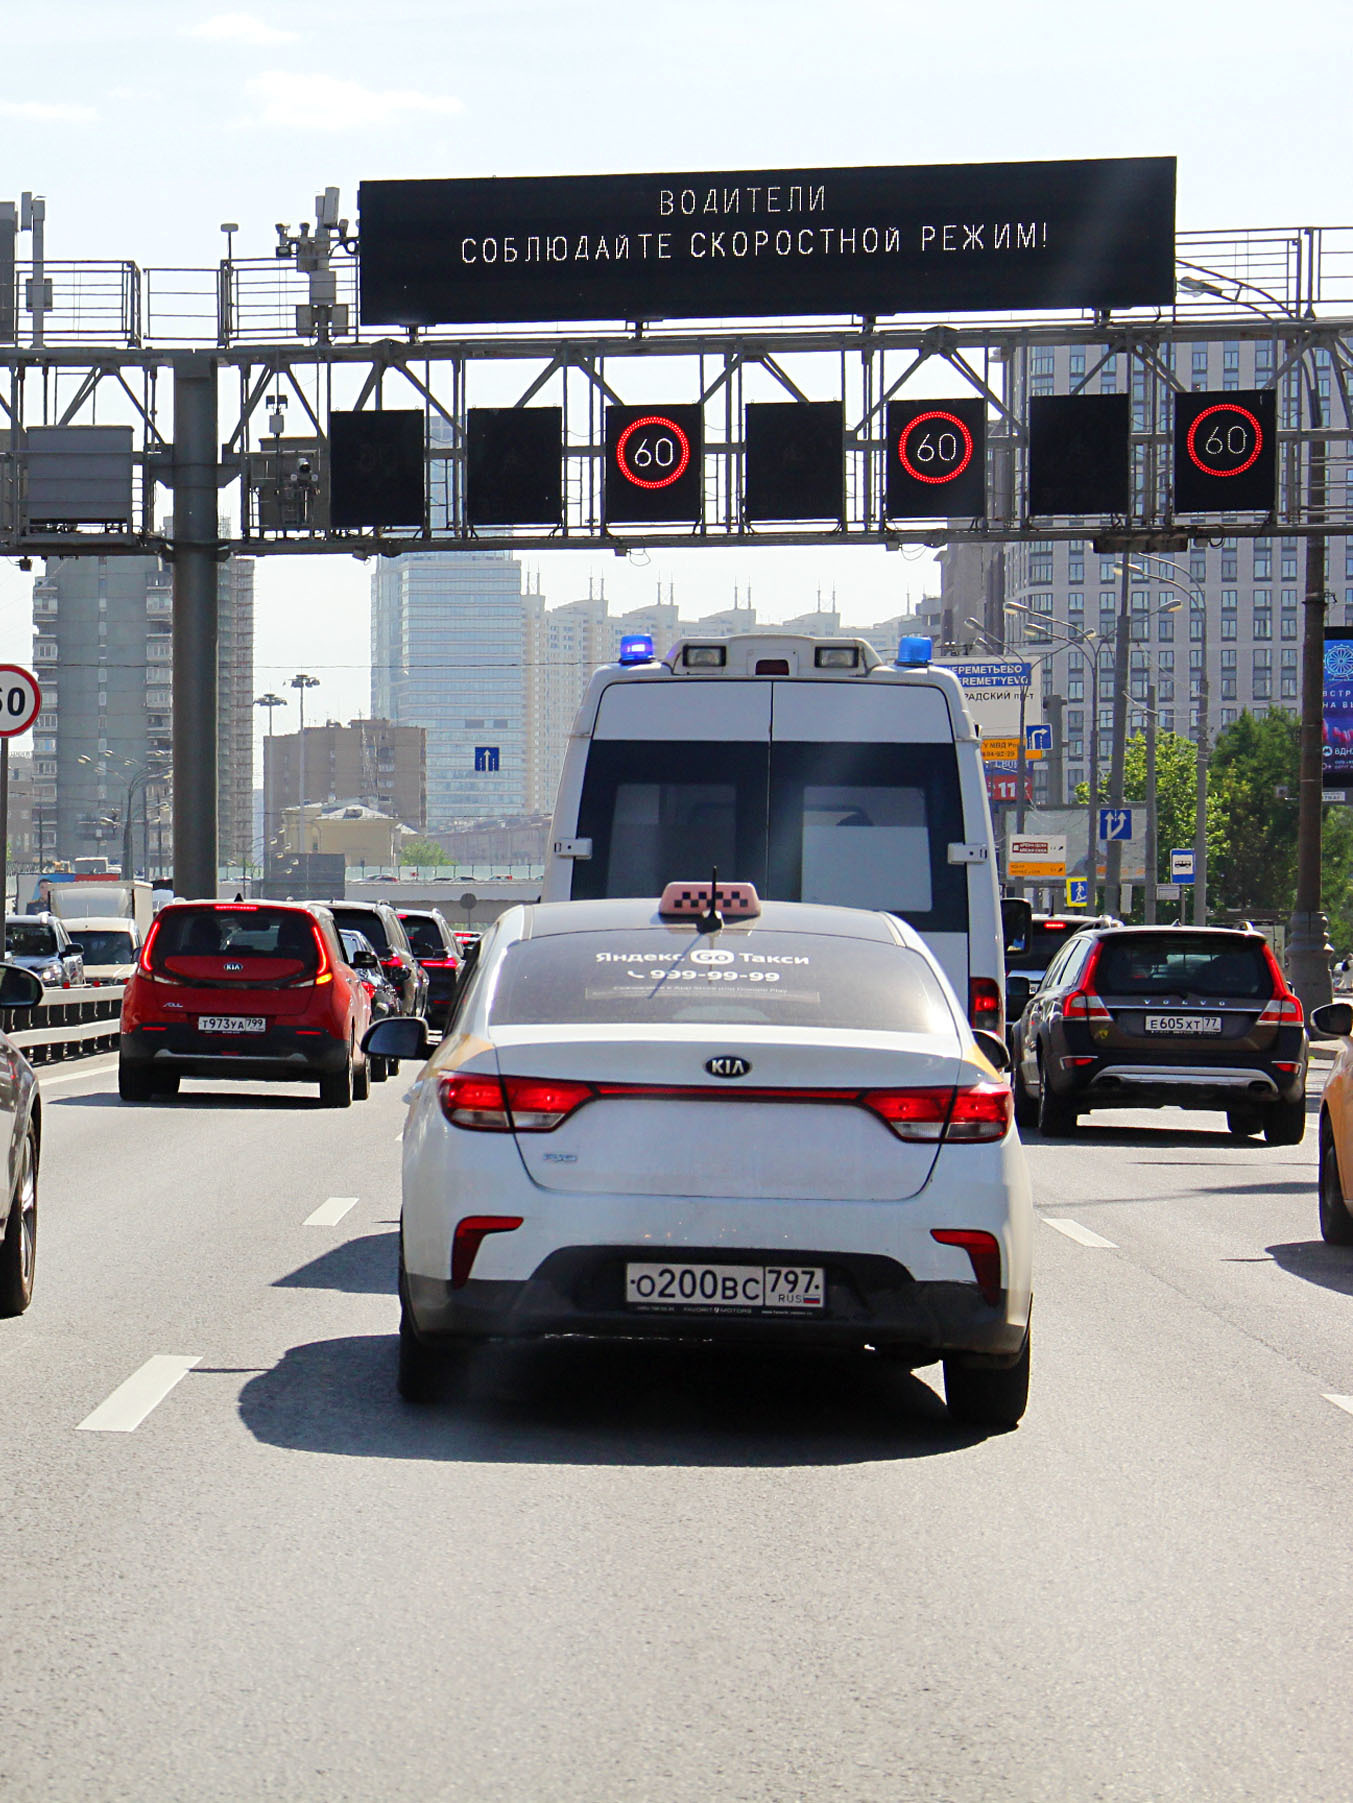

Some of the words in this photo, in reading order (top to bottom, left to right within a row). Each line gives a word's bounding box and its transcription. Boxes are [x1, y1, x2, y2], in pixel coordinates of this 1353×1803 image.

[660, 186, 825, 216] ВОДИТЕЛИ
[461, 233, 672, 263] СОБЛЮДАЙТЕ
[690, 227, 900, 258] СКОРОСТНОЙ
[921, 222, 1047, 251] РЕЖИМ!
[917, 433, 957, 462] 60
[1205, 426, 1247, 455] 60
[634, 437, 674, 467] 60
[947, 664, 1023, 674] ЕРЕМЕТЬЕВО
[595, 952, 686, 963] Яндекс
[739, 952, 810, 965] Такси
[650, 969, 780, 982] 999-99-99
[1204, 1018, 1217, 1027] 77
[711, 1059, 746, 1074] KIA
[767, 1270, 816, 1294] 797
[778, 1294, 802, 1304] RUS
